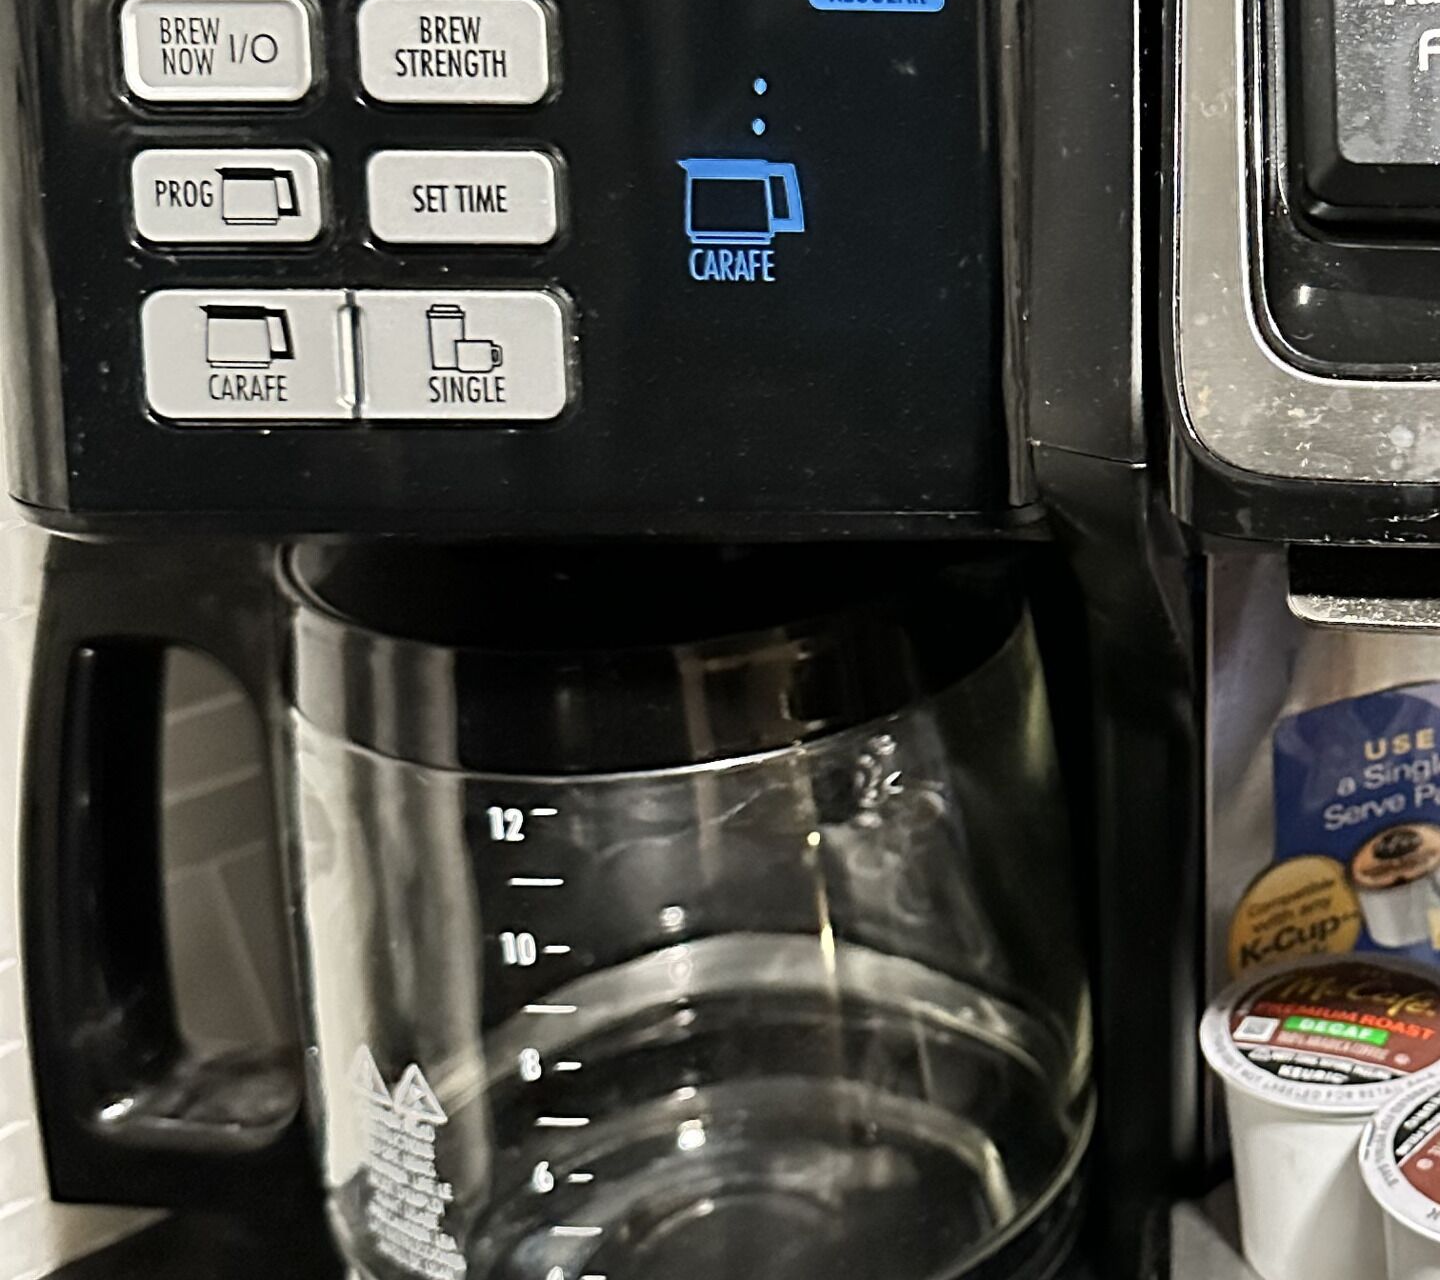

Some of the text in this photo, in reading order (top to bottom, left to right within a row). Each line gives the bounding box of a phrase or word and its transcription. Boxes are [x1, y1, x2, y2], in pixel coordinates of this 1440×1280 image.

[159, 16, 220, 45] BREW
[419, 16, 481, 45] BREW
[162, 47, 215, 76] NOW
[395, 48, 508, 79] STRENGTH
[154, 179, 214, 209] PROG
[413, 184, 509, 214] SET TIME
[688, 248, 776, 282] CARAFE
[208, 375, 289, 403] CARAFE
[429, 376, 507, 405] SINGLE
[1364, 727, 1436, 760] USE
[1337, 776, 1357, 797] a
[487, 805, 526, 842] 12
[1323, 793, 1406, 832] Serve
[501, 930, 537, 966] 10
[1254, 1001, 1359, 1023] PREMIUM
[1359, 1014, 1438, 1041] ROAST
[1299, 1018, 1375, 1041] DECAF
[518, 1047, 542, 1082] 8
[531, 1160, 555, 1195] 6
